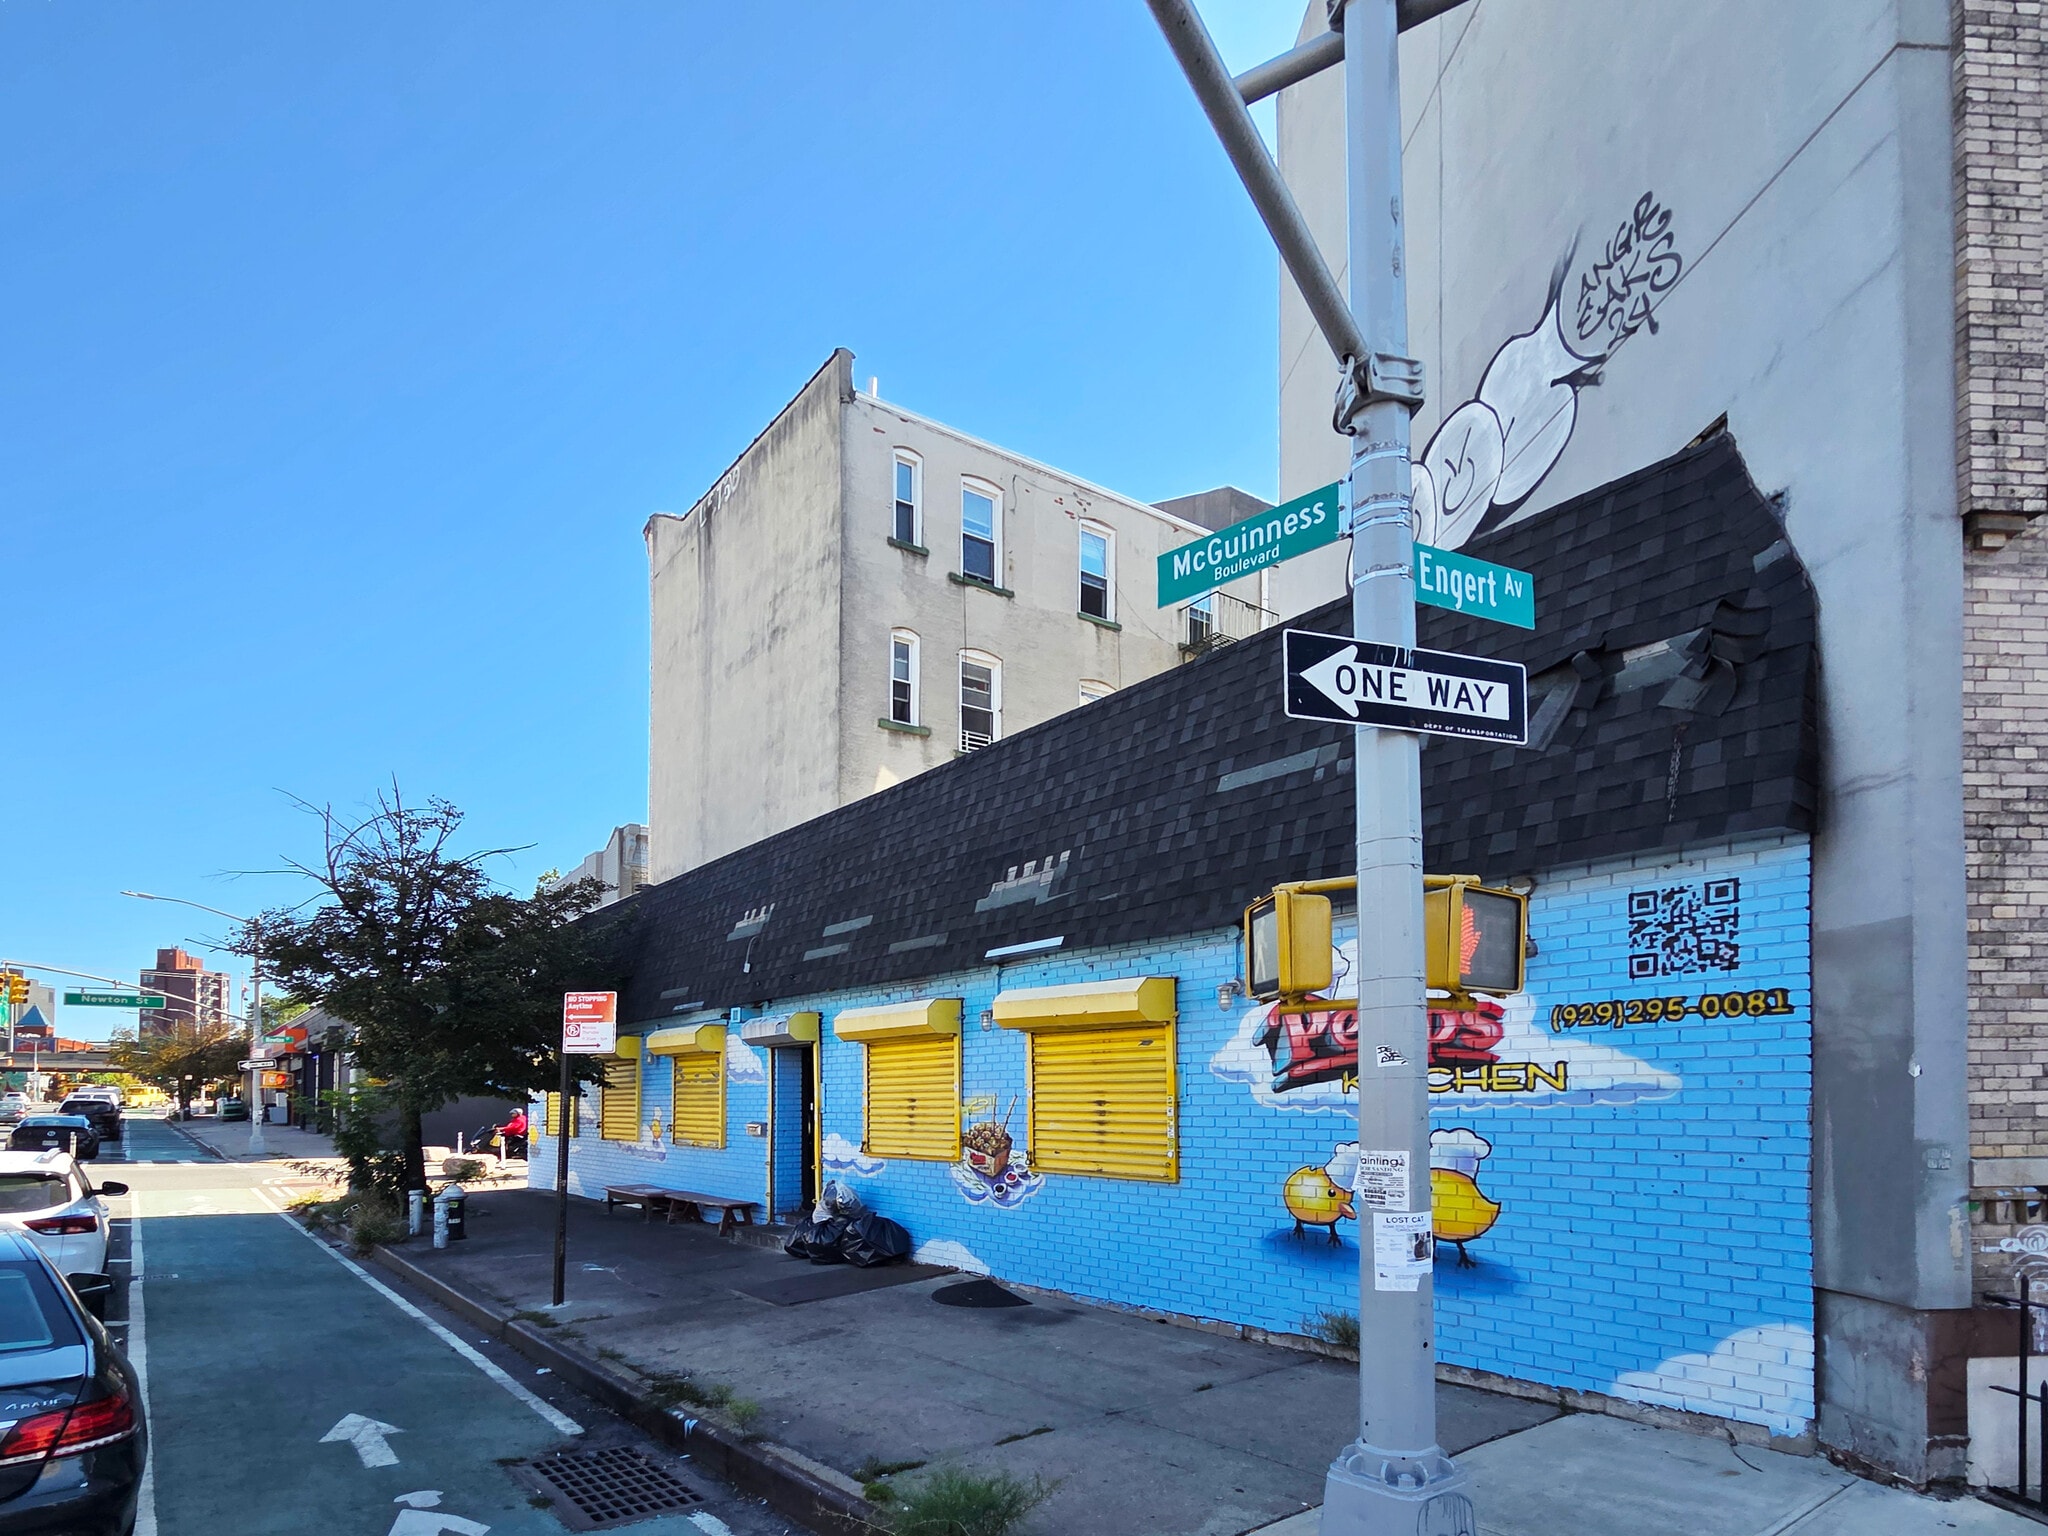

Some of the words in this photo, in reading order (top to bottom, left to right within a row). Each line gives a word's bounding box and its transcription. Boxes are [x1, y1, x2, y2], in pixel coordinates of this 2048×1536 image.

[1173, 501, 1326, 580] McGuinness
[1214, 544, 1280, 581] Boulevard
[1419, 551, 1497, 610] Engert
[1504, 572, 1522, 598] Av
[1335, 664, 1407, 702] ONE
[1427, 676, 1494, 713] WAY
[1423, 722, 1442, 730] DEPT
[1457, 727, 1518, 739] TRANSPORTATION
[81, 995, 128, 1004] Newton
[136, 997, 149, 1005] St
[1551, 989, 1794, 1033] (929)295-0081
[1341, 1061, 1567, 1094] KCHEN
[1360, 1157, 1399, 1168] ainting
[1386, 1216, 1409, 1224] LOST
[1411, 1215, 1424, 1223] CAT
